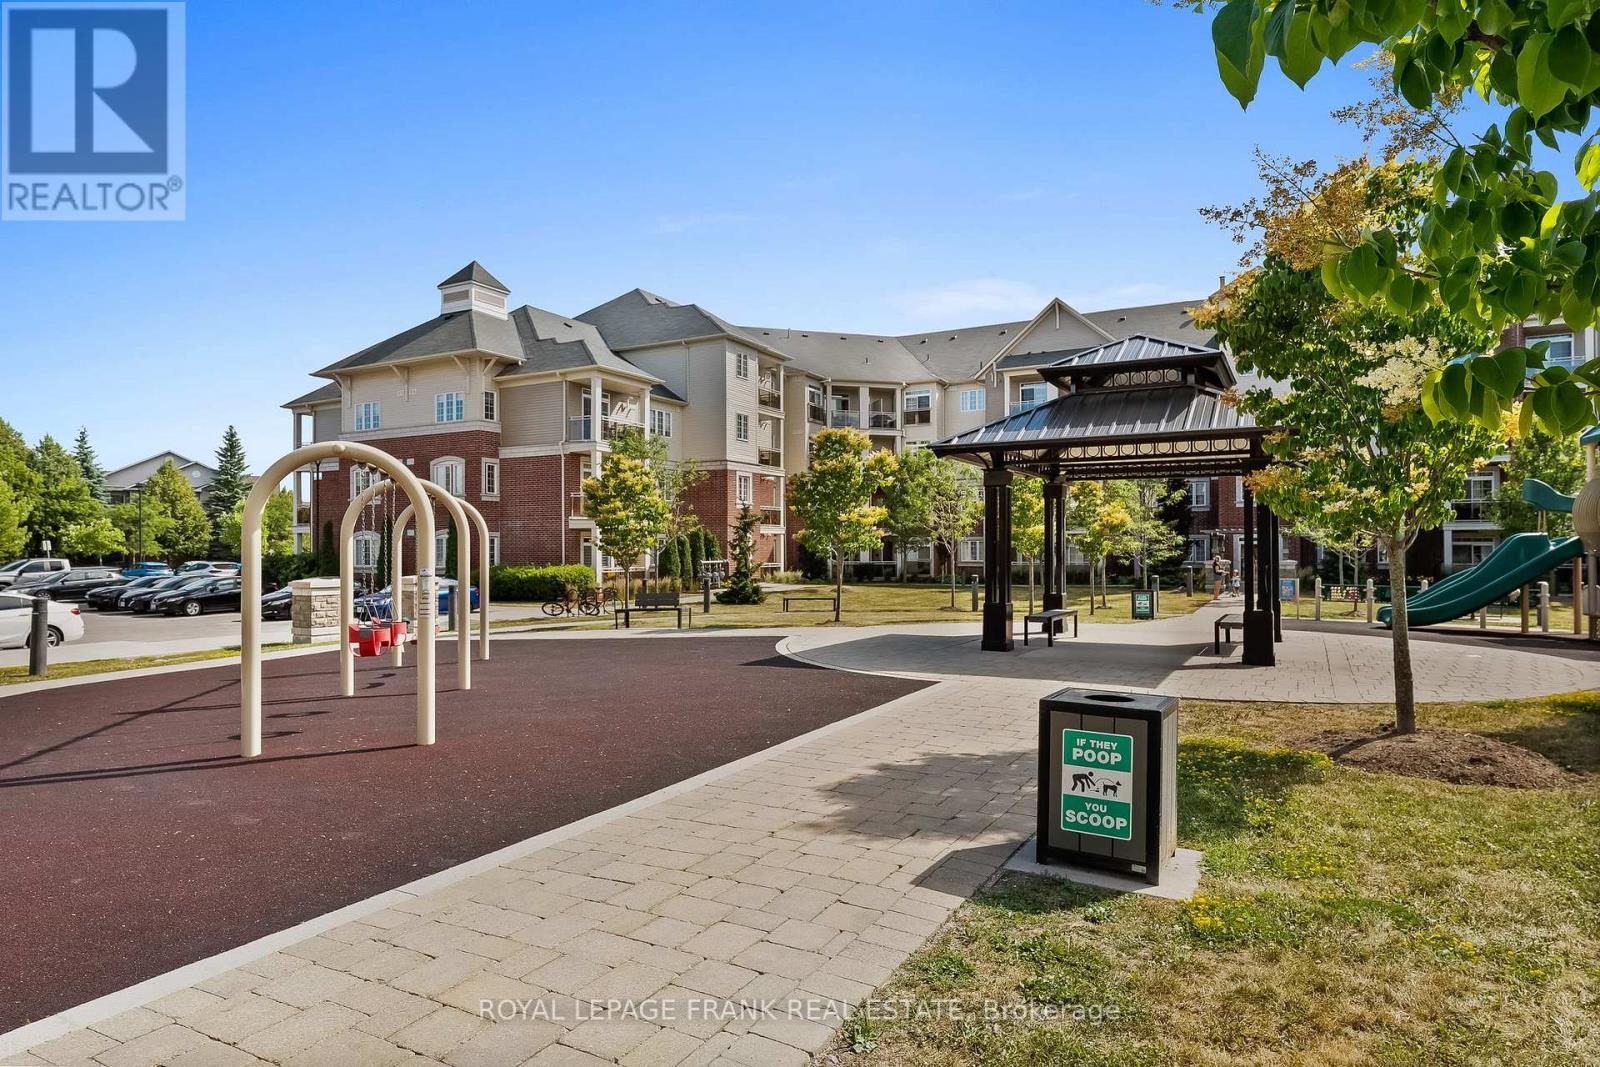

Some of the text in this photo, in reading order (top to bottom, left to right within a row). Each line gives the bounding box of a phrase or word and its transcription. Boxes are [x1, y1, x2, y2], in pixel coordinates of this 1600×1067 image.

[1076, 738, 1117, 750] IF THEY
[1072, 747, 1122, 764] POOP
[1085, 802, 1107, 812] YOU
[1065, 809, 1127, 829] SCOOP
